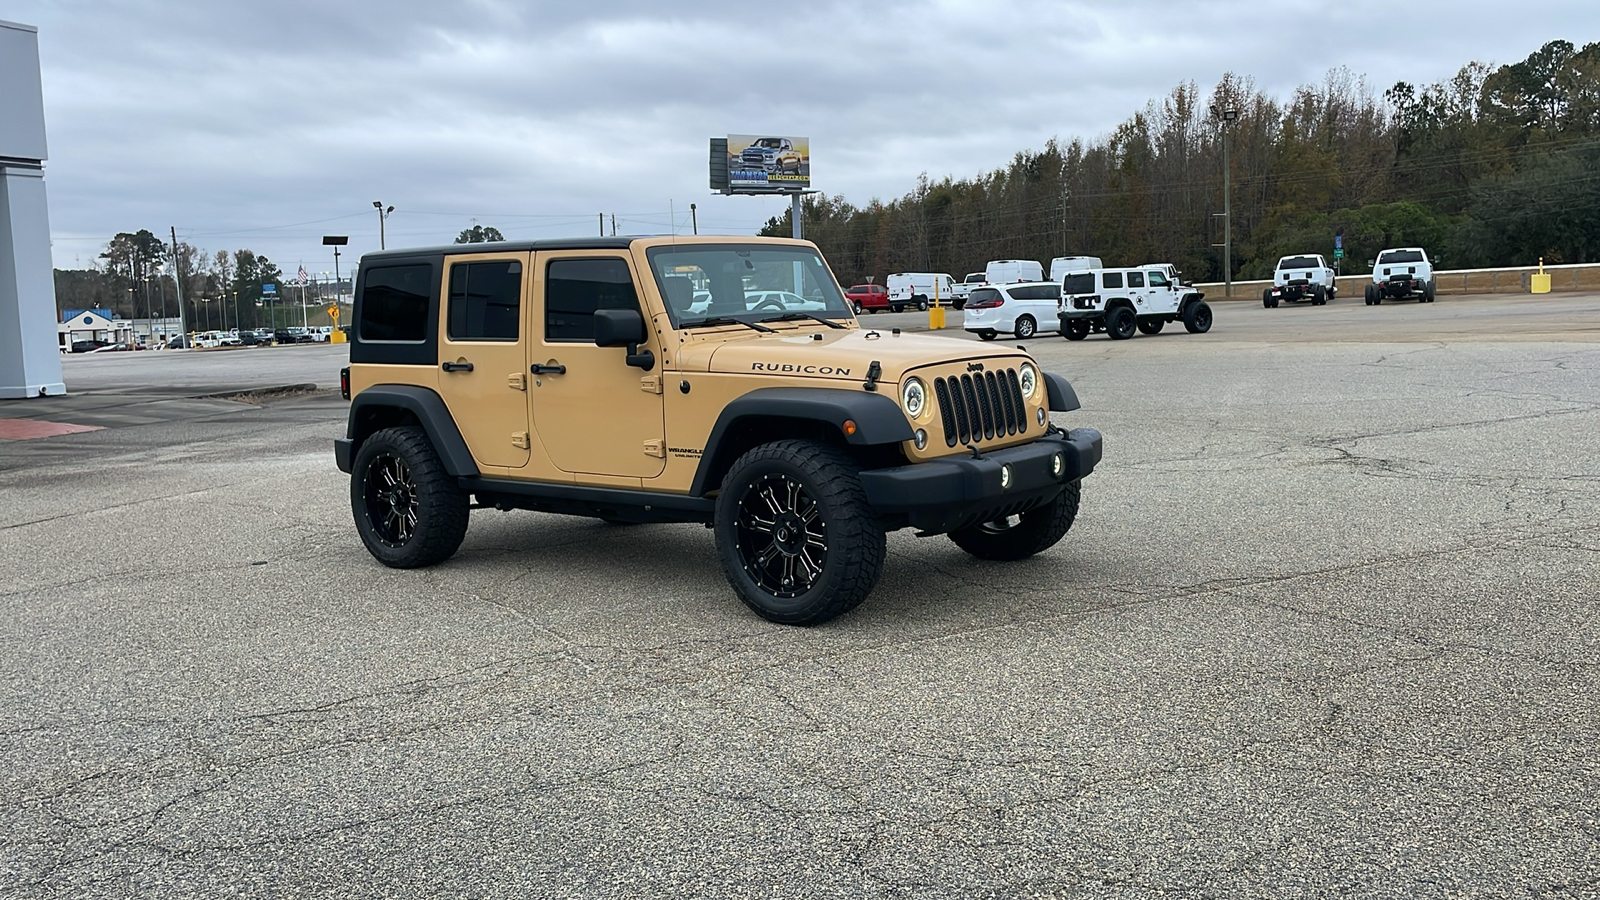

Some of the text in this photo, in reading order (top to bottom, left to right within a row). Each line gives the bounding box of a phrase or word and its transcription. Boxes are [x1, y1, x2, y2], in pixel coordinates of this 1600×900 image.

[730, 170, 768, 180] THOMSON
[751, 362, 851, 376] RUBICON
[967, 362, 984, 372] Jeep
